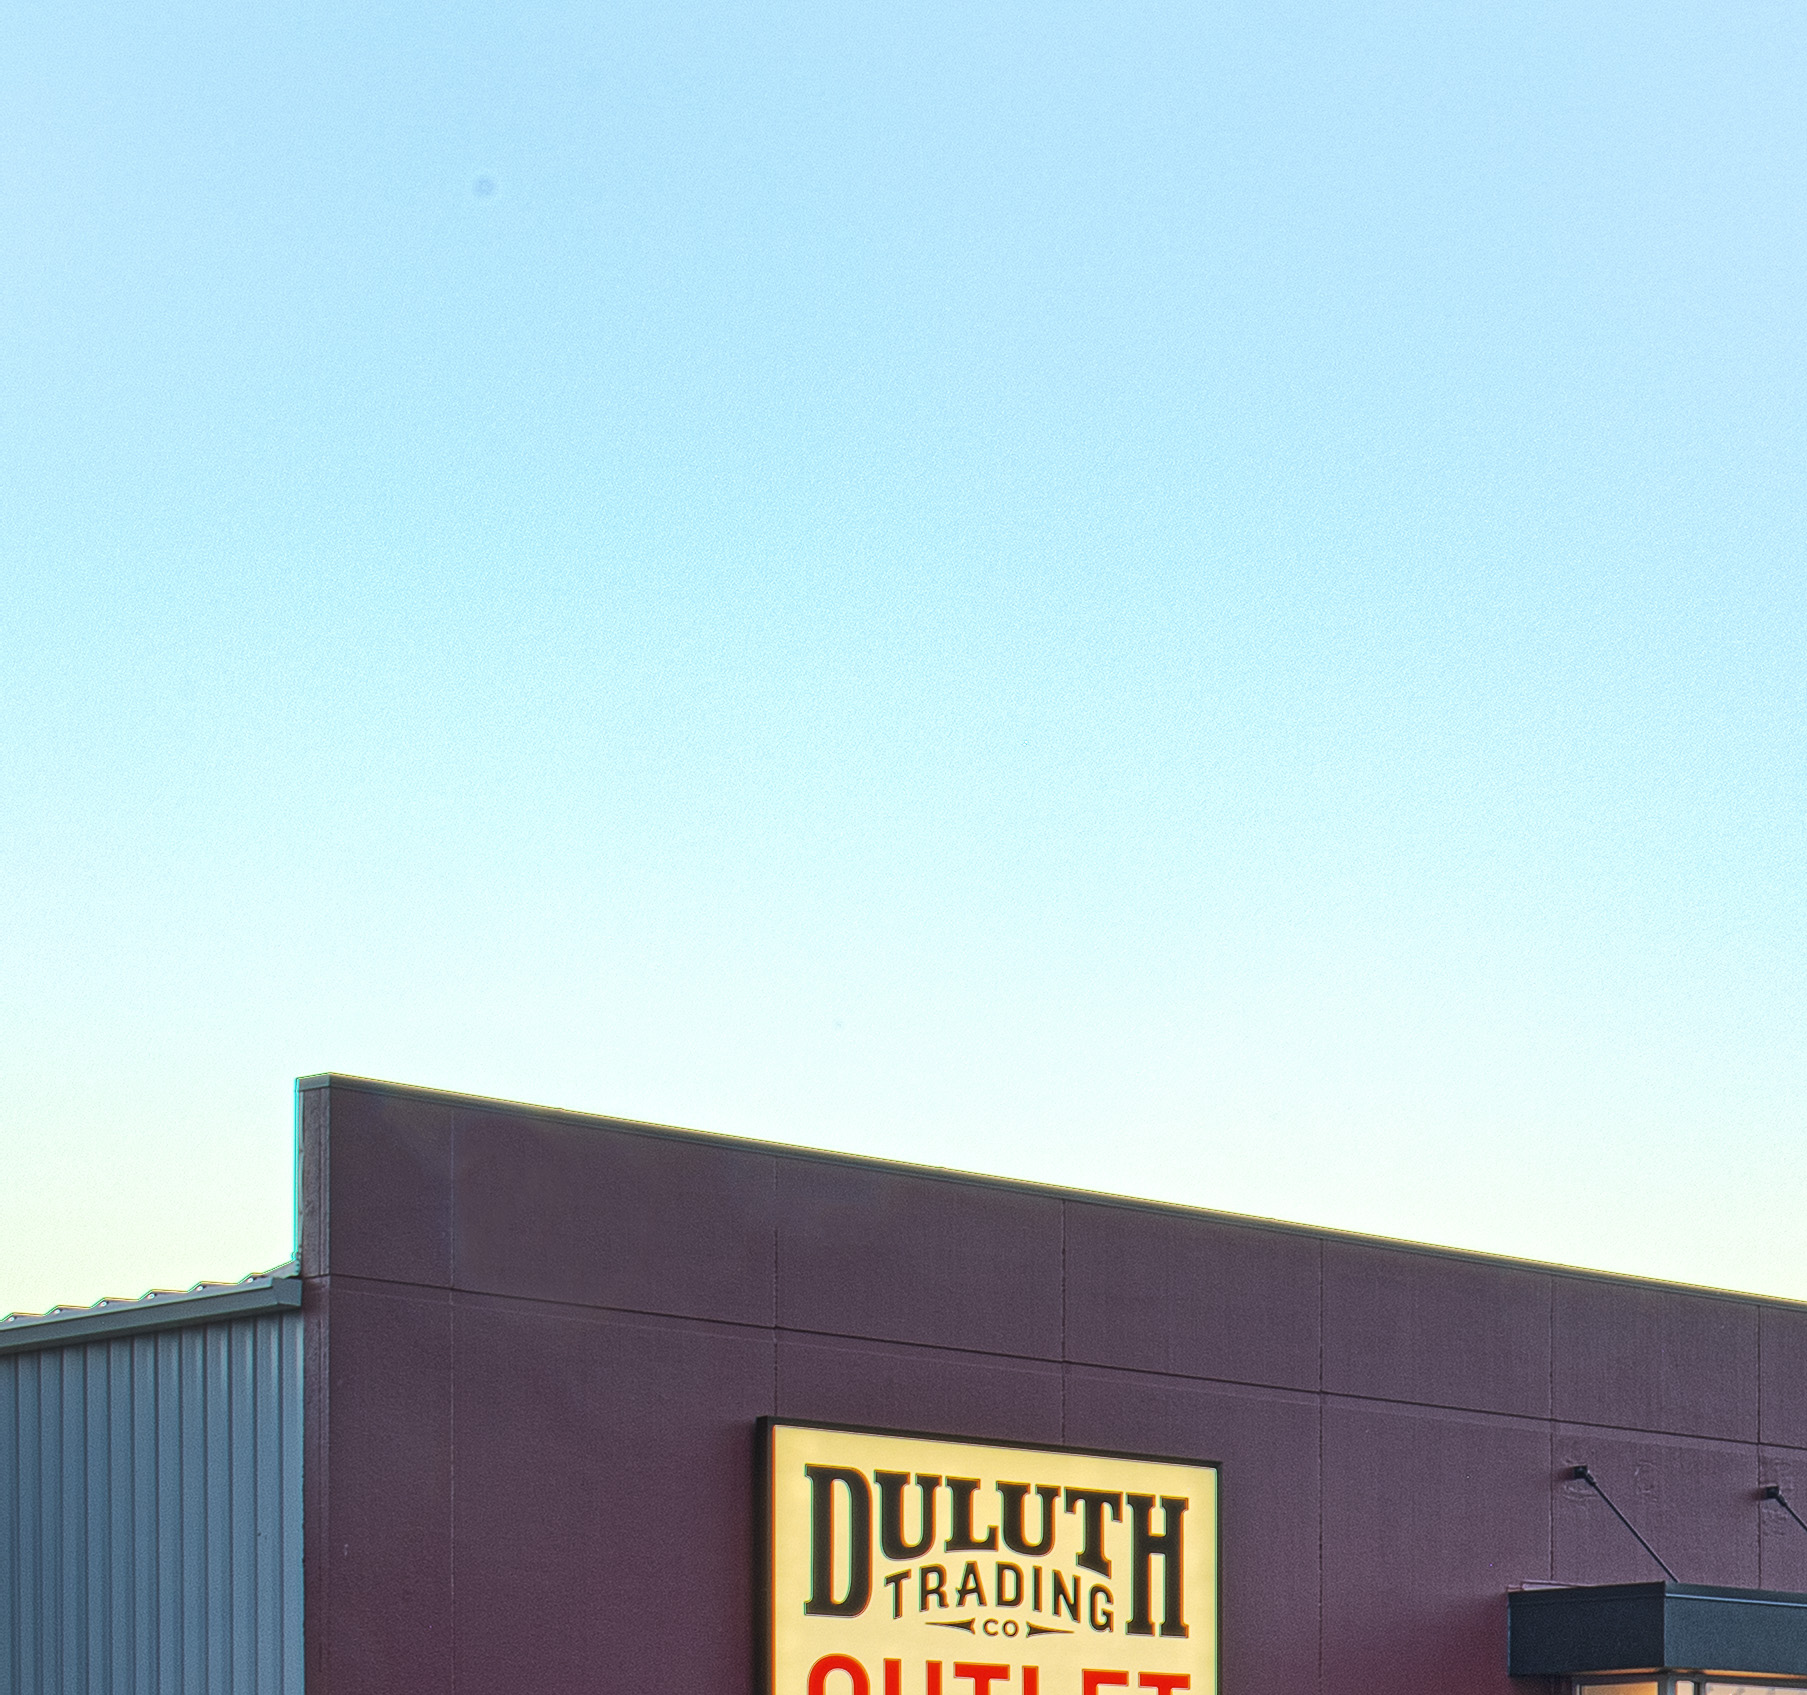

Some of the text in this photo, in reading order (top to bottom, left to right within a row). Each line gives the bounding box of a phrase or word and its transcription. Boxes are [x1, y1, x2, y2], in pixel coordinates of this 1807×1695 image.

[803, 1463, 1190, 1639] DULUTH
[884, 1560, 1115, 1633] TRADING
[982, 1618, 1018, 1638] CO
